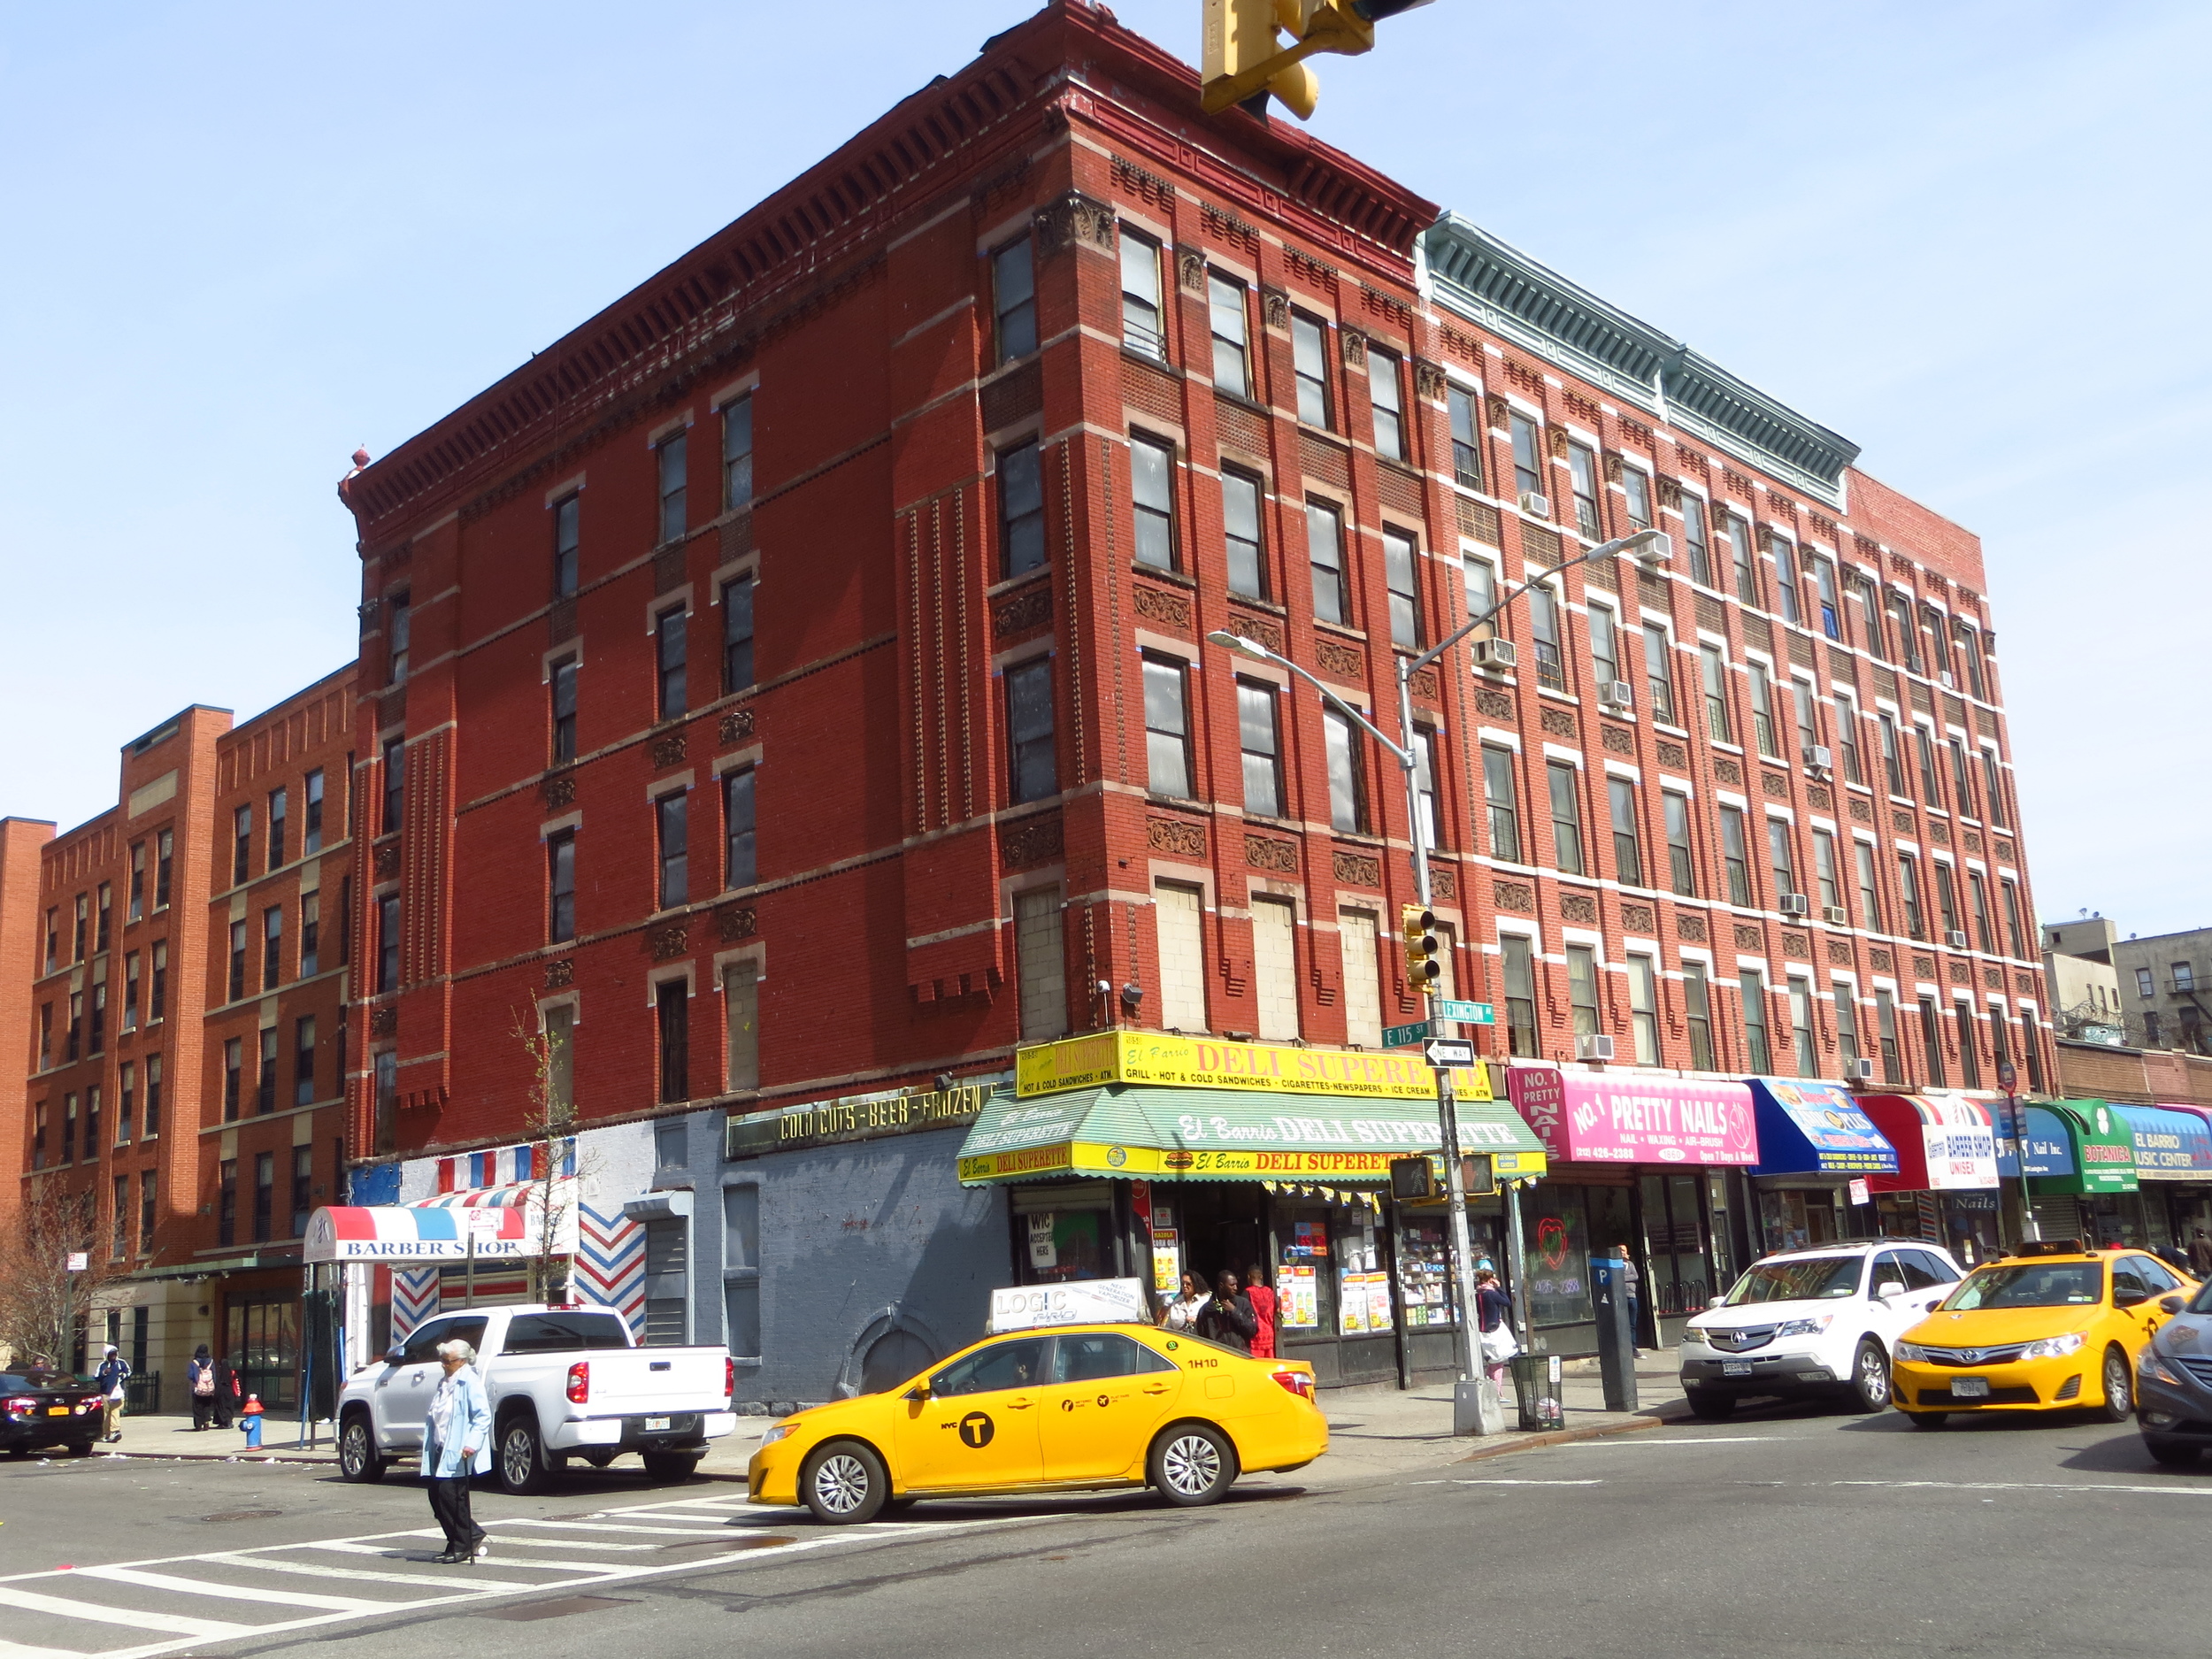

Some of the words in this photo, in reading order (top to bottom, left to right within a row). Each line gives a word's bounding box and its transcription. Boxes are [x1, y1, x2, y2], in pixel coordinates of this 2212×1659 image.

[1443, 1002, 1484, 1021] LEXINGTON
[1387, 1031, 1393, 1045] E
[1398, 1027, 1411, 1043] 115
[1056, 1044, 1071, 1075] DELI
[1074, 1037, 1114, 1072] SUPERETTE
[1194, 1044, 1282, 1078] DELI
[1432, 1048, 1446, 1058] ONE
[1453, 1048, 1468, 1059] WAY
[1024, 1082, 1033, 1093] HOT
[1036, 1081, 1041, 1091] &
[1042, 1079, 1056, 1089] COLD
[1058, 1073, 1094, 1087] SANDWICHES
[1125, 1069, 1150, 1079] GRILL
[1160, 1071, 1175, 1081] HOT
[1180, 1073, 1187, 1082] &
[1191, 1073, 1213, 1083] COLD
[1217, 1076, 1271, 1087] SANDWICHES
[1524, 1072, 1548, 1087] NO.
[1551, 1071, 1557, 1084] 1
[1524, 1087, 1560, 1102] PRETTY
[820, 1104, 856, 1134] CUTS
[870, 1096, 908, 1127] BEER
[923, 1083, 981, 1118] FROZEN
[1573, 1102, 1598, 1135] NO.
[1595, 1093, 1605, 1116] 1
[1610, 1094, 1672, 1132] PRETTY
[1679, 1100, 1727, 1135] NAILS
[1179, 1115, 1207, 1141] El
[1210, 1117, 1278, 1140] Barrio
[1271, 1117, 1353, 1142] DELI
[1838, 1112, 1872, 1130] PLUS
[1619, 1133, 1638, 1144] NAIL
[1647, 1134, 1676, 1146] WAXING
[1685, 1136, 1724, 1148] AIR-BRUSH
[1947, 1135, 1973, 1158] BARBER
[1974, 1135, 1991, 1158] SHOP
[2032, 1141, 2047, 1155] Nail
[2135, 1133, 2146, 1148] EL
[2147, 1133, 2180, 1149] BARRIO
[1196, 1153, 1211, 1170] El
[1216, 1151, 1249, 1169] Barrio
[1256, 1153, 1302, 1170] DELI
[1576, 1147, 1591, 1158] (212)
[1593, 1148, 1634, 1159] 426-2388
[1700, 1150, 1714, 1162] Open
[1721, 1151, 1733, 1164] Days
[1735, 1152, 1740, 1161] A
[1740, 1152, 1755, 1162] Week
[2084, 1145, 2131, 1163] BOTANICA
[2160, 1153, 2193, 1167] CENTER
[964, 1158, 971, 1176] El
[972, 1157, 990, 1174] Barrio
[996, 1153, 1017, 1172] DELI
[1018, 1147, 1067, 1170] SUPERETTE
[1949, 1161, 1976, 1175] UNISEX
[1956, 1197, 1995, 1209] Nails
[1031, 1213, 1050, 1230] WIC
[347, 1242, 443, 1256] BARBER
[453, 1241, 517, 1256] SHOP
[1036, 1246, 1048, 1256] HERE
[1599, 1269, 1607, 1284] P
[1097, 1284, 1135, 1300] GENERATION
[1535, 1279, 1579, 1294] 426-2388
[1098, 1290, 1131, 1304] VAPORIZER
[1033, 1310, 1077, 1323] PRO
[1187, 1359, 1217, 1369] 1H10
[966, 1417, 986, 1444] T
